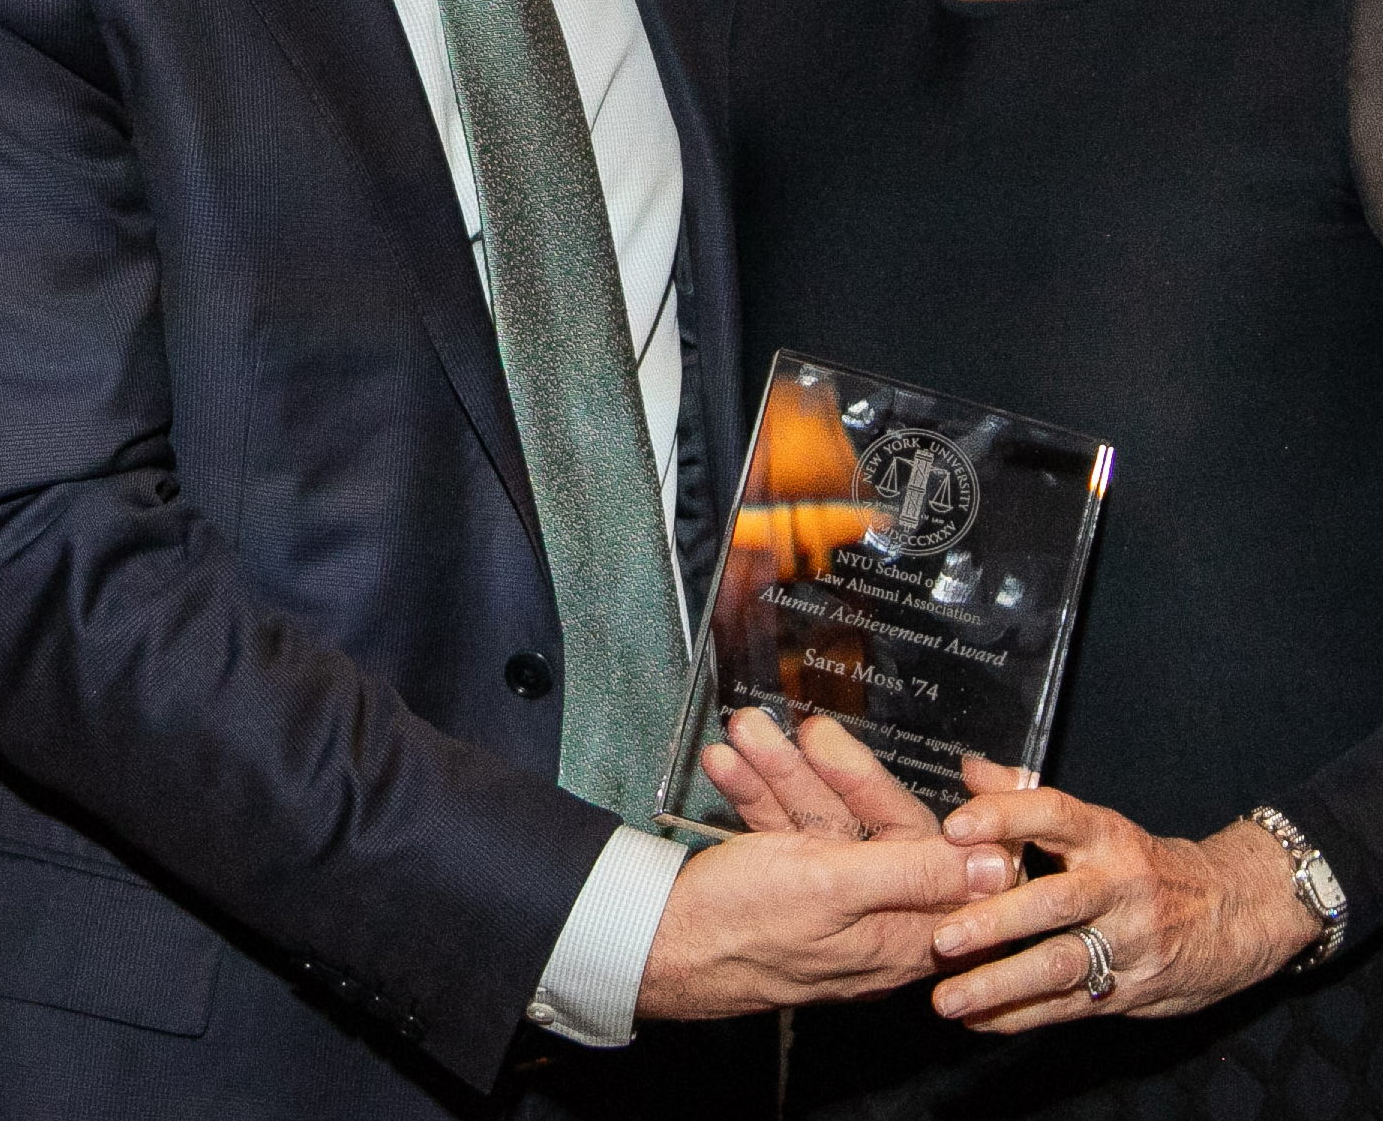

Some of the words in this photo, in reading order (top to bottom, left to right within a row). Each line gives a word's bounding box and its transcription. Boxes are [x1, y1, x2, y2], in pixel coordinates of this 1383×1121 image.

[863, 453, 883, 484] NEW
[883, 437, 921, 454] YORK
[930, 441, 970, 511] UNIVERSITY
[836, 550, 873, 571] NYU
[875, 562, 923, 585] School
[814, 568, 845, 587] Law
[847, 578, 900, 603] Alumni
[902, 593, 982, 626] Association
[759, 584, 828, 617] Alumni
[829, 606, 943, 649] Achievement
[944, 637, 1008, 668] Award
[803, 647, 847, 676] Sara
[851, 661, 905, 693] Moss
[912, 676, 939, 702] '74
[733, 681, 748, 694] In
[749, 684, 786, 705] honor
[786, 697, 813, 712] and
[813, 705, 877, 731] recognition
[880, 723, 897, 738] of
[895, 729, 924, 744] your
[925, 735, 986, 760] significant
[873, 748, 897, 762] and
[910, 781, 938, 798] Law
[939, 789, 971, 807] Scho
